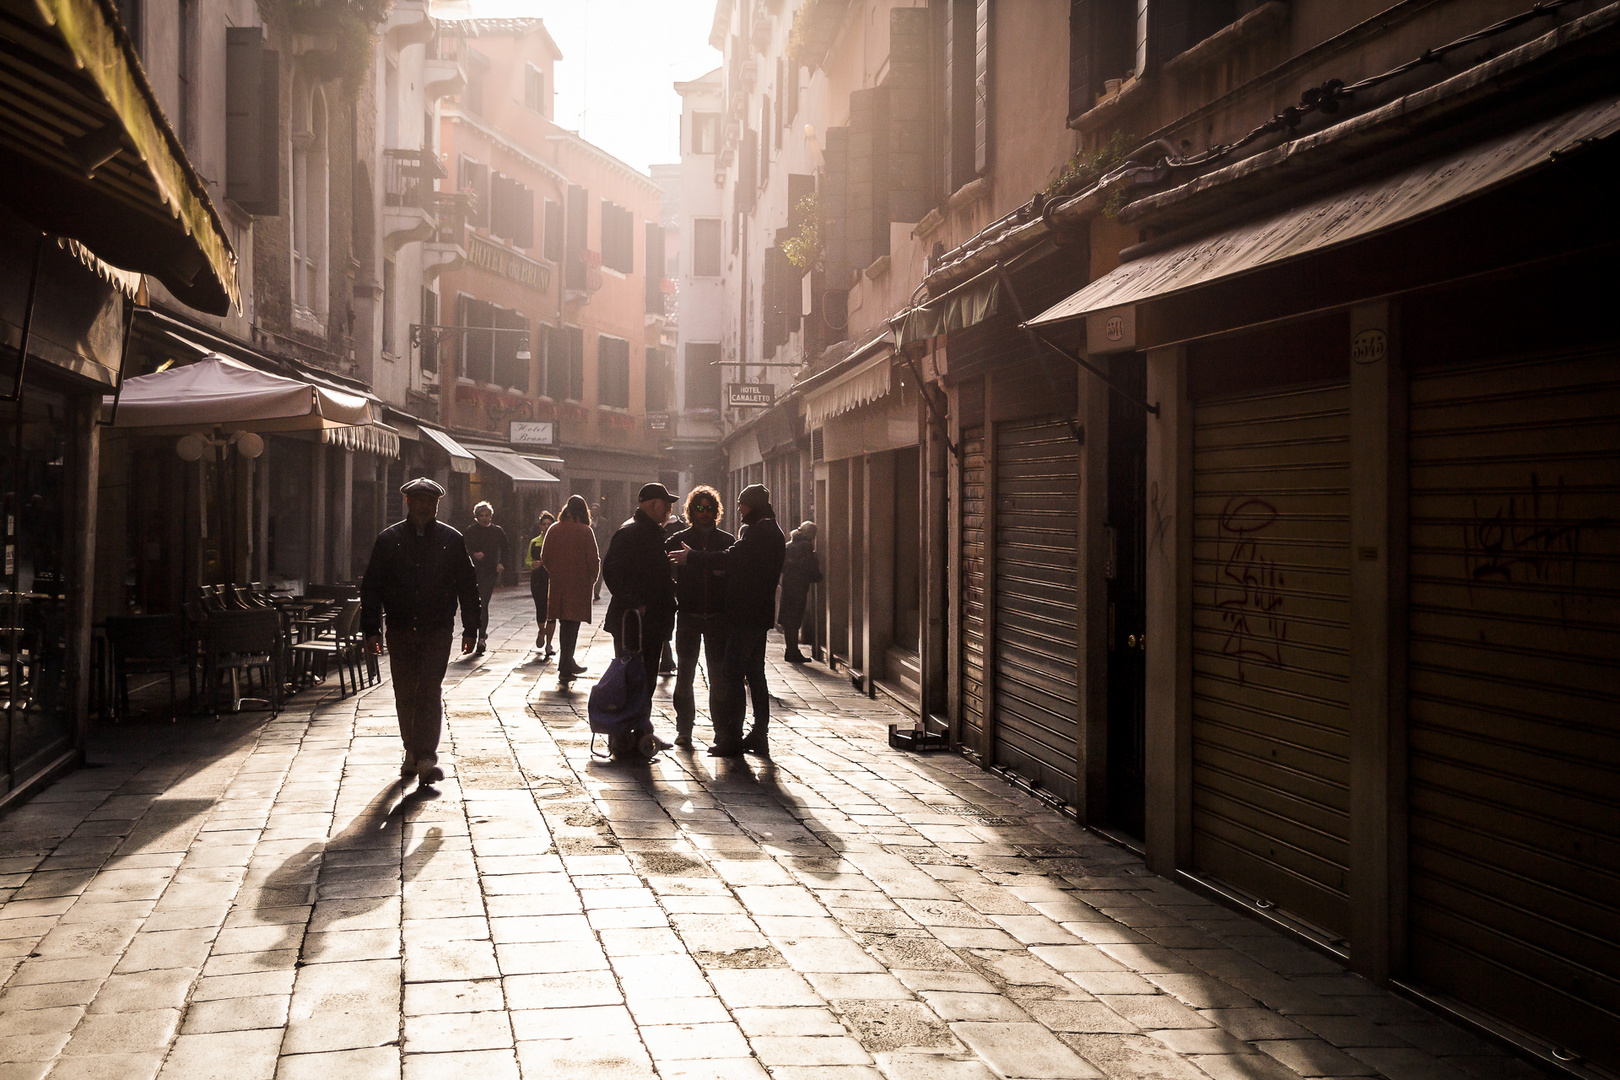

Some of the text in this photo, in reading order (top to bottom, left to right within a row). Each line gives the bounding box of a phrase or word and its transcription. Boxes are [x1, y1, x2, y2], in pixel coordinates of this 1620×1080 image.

[469, 239, 507, 275] HOTEL
[1353, 336, 1384, 360] 5545
[740, 386, 762, 394] HOTEL
[731, 394, 771, 402] CANALETTO
[514, 423, 549, 432] Hotel
[515, 433, 548, 441] Bruno
